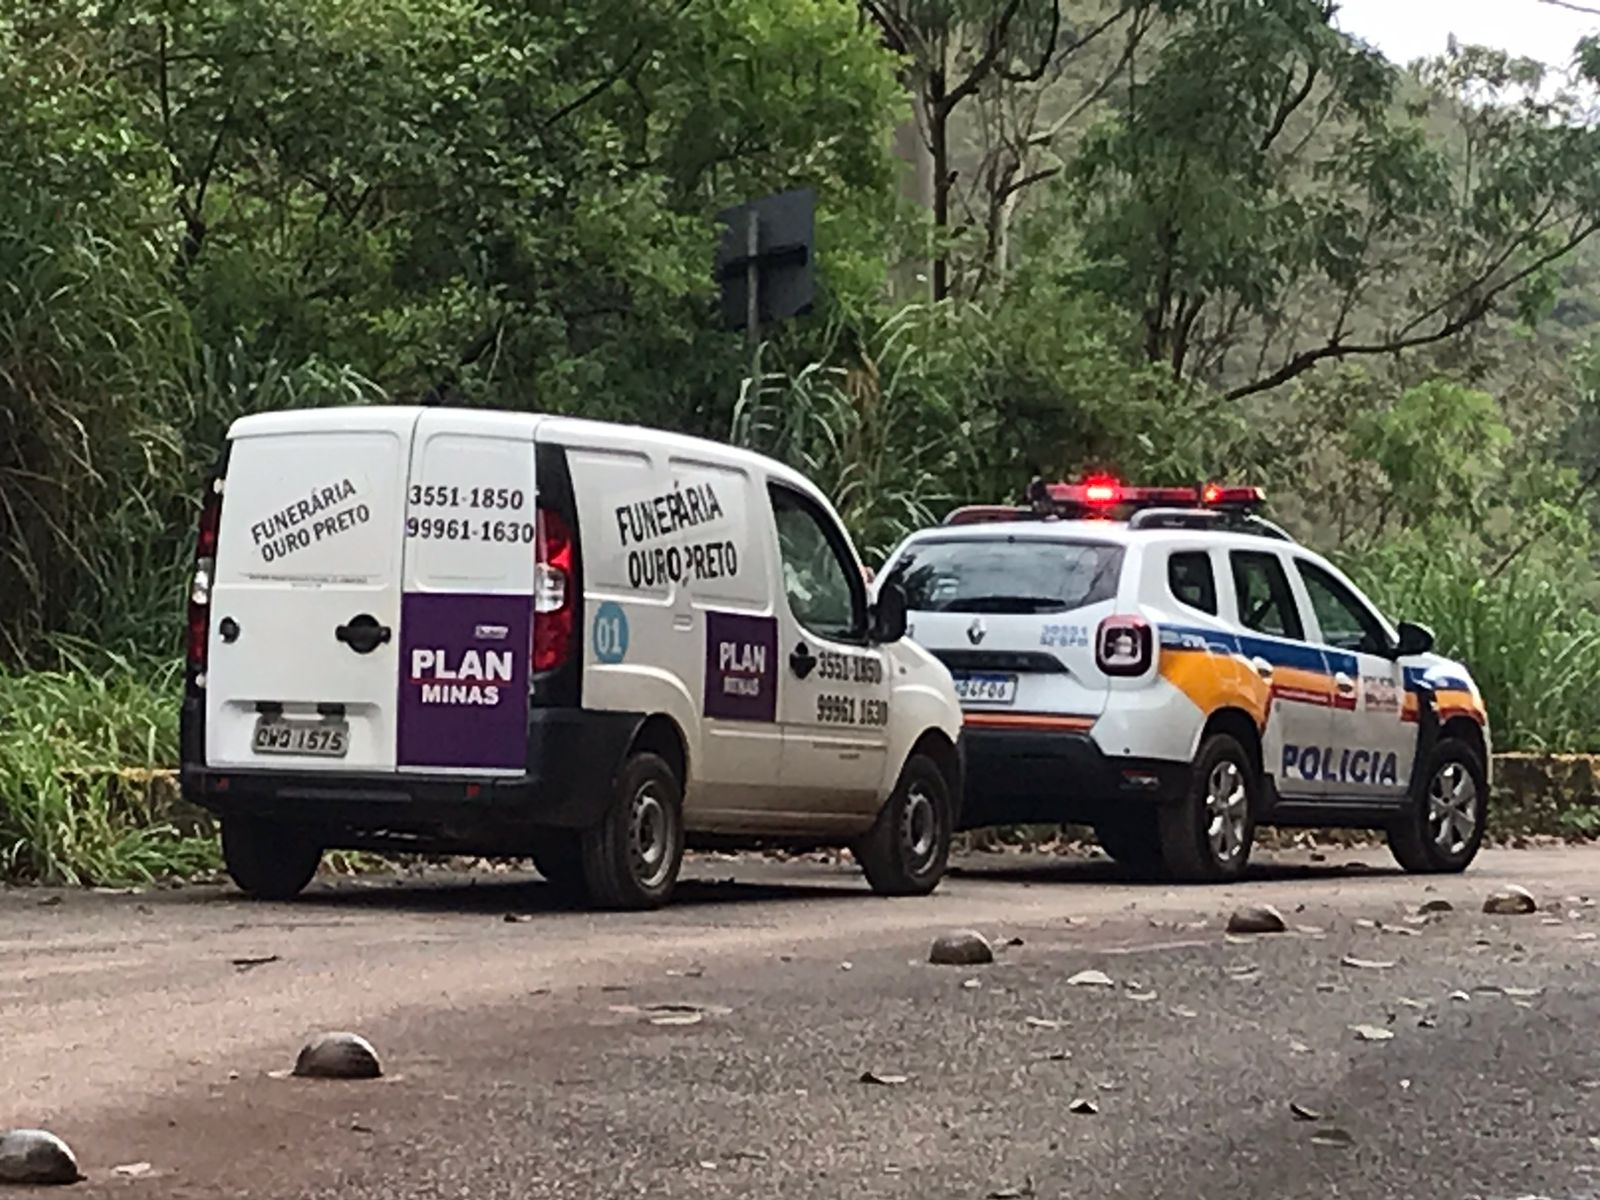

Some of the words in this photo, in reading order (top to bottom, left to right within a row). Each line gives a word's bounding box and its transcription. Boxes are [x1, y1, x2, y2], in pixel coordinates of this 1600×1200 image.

[251, 478, 357, 545] FUNERÁRIA
[409, 485, 524, 510] 3551-1850
[261, 528, 310, 563] OURO
[312, 503, 370, 541] PRETO
[406, 517, 535, 544] 99961-1630
[628, 546, 682, 588] OURO
[597, 617, 622, 654] 01
[411, 648, 513, 681] PLAN
[719, 641, 766, 673] PLAN
[421, 683, 499, 705] MINAS
